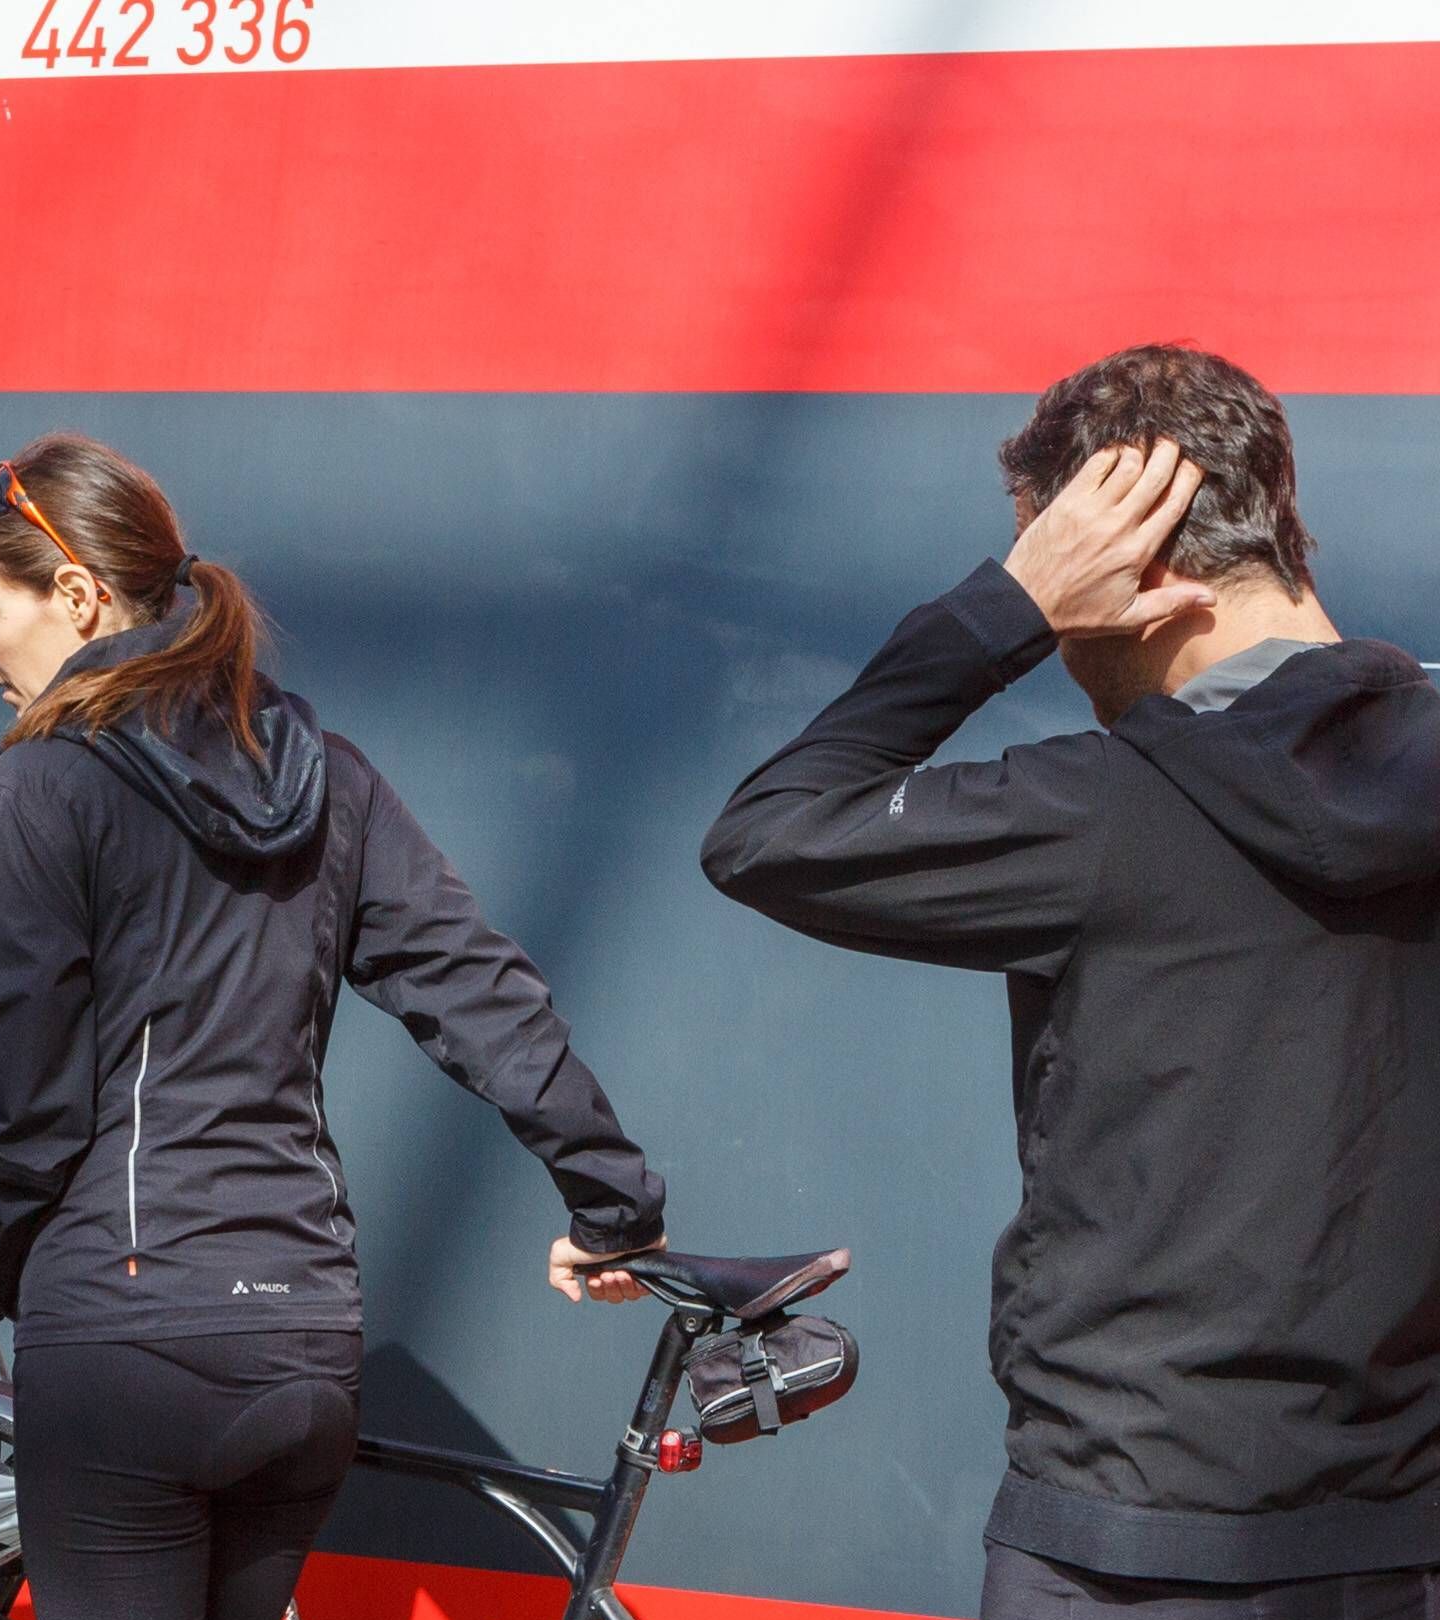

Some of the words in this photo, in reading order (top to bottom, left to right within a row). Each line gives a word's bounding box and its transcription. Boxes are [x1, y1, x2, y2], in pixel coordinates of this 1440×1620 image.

[21, 0, 155, 69] 442
[176, 0, 313, 66] 336
[252, 1282, 291, 1294] VAUDE
